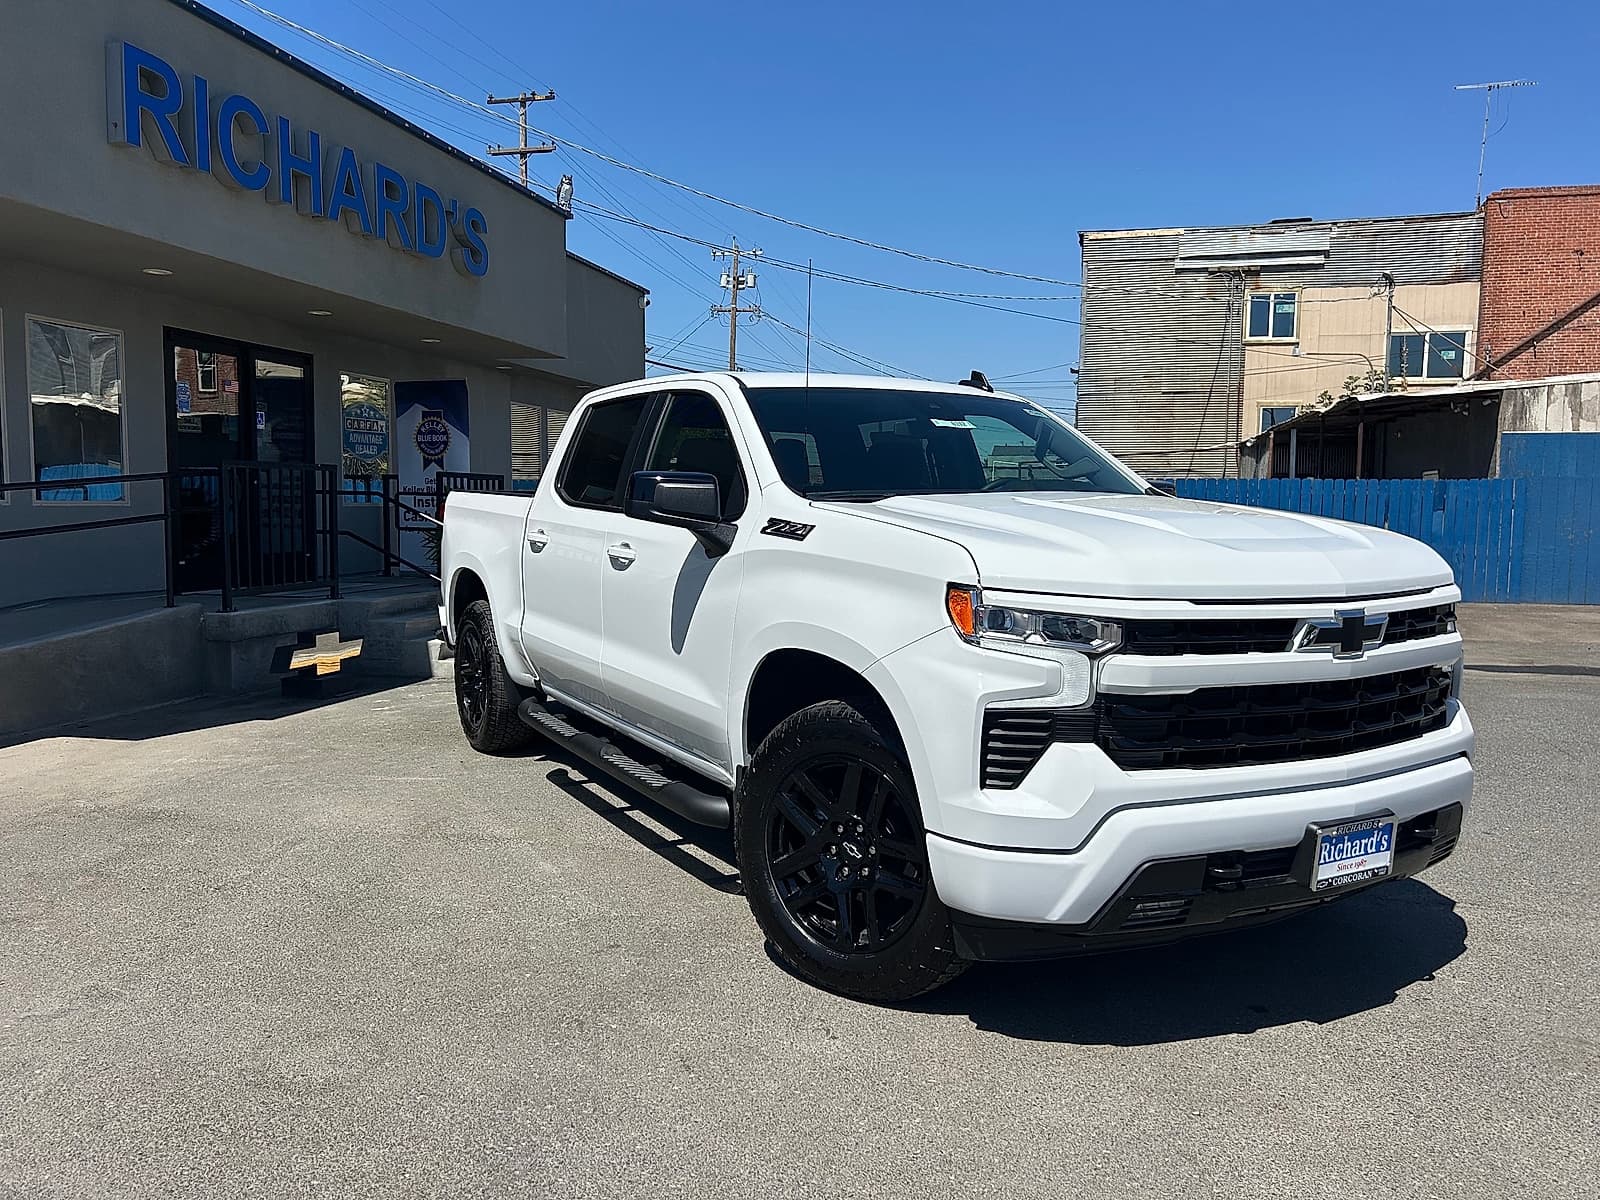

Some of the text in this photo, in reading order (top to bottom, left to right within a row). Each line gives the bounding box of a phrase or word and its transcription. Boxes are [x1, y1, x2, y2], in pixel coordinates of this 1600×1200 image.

[122, 42, 489, 278] RICHARD'S
[346, 418, 385, 433] CARFAX
[420, 421, 446, 433] KELLEY
[349, 433, 384, 445] ADVANTAGE
[417, 434, 448, 442] BLUE BOOK
[355, 444, 378, 455] DEALER
[414, 496, 435, 507] Inst
[1320, 830, 1388, 863] Richard's
[1336, 861, 1353, 872] Since
[1332, 870, 1373, 885] CORCORAN
